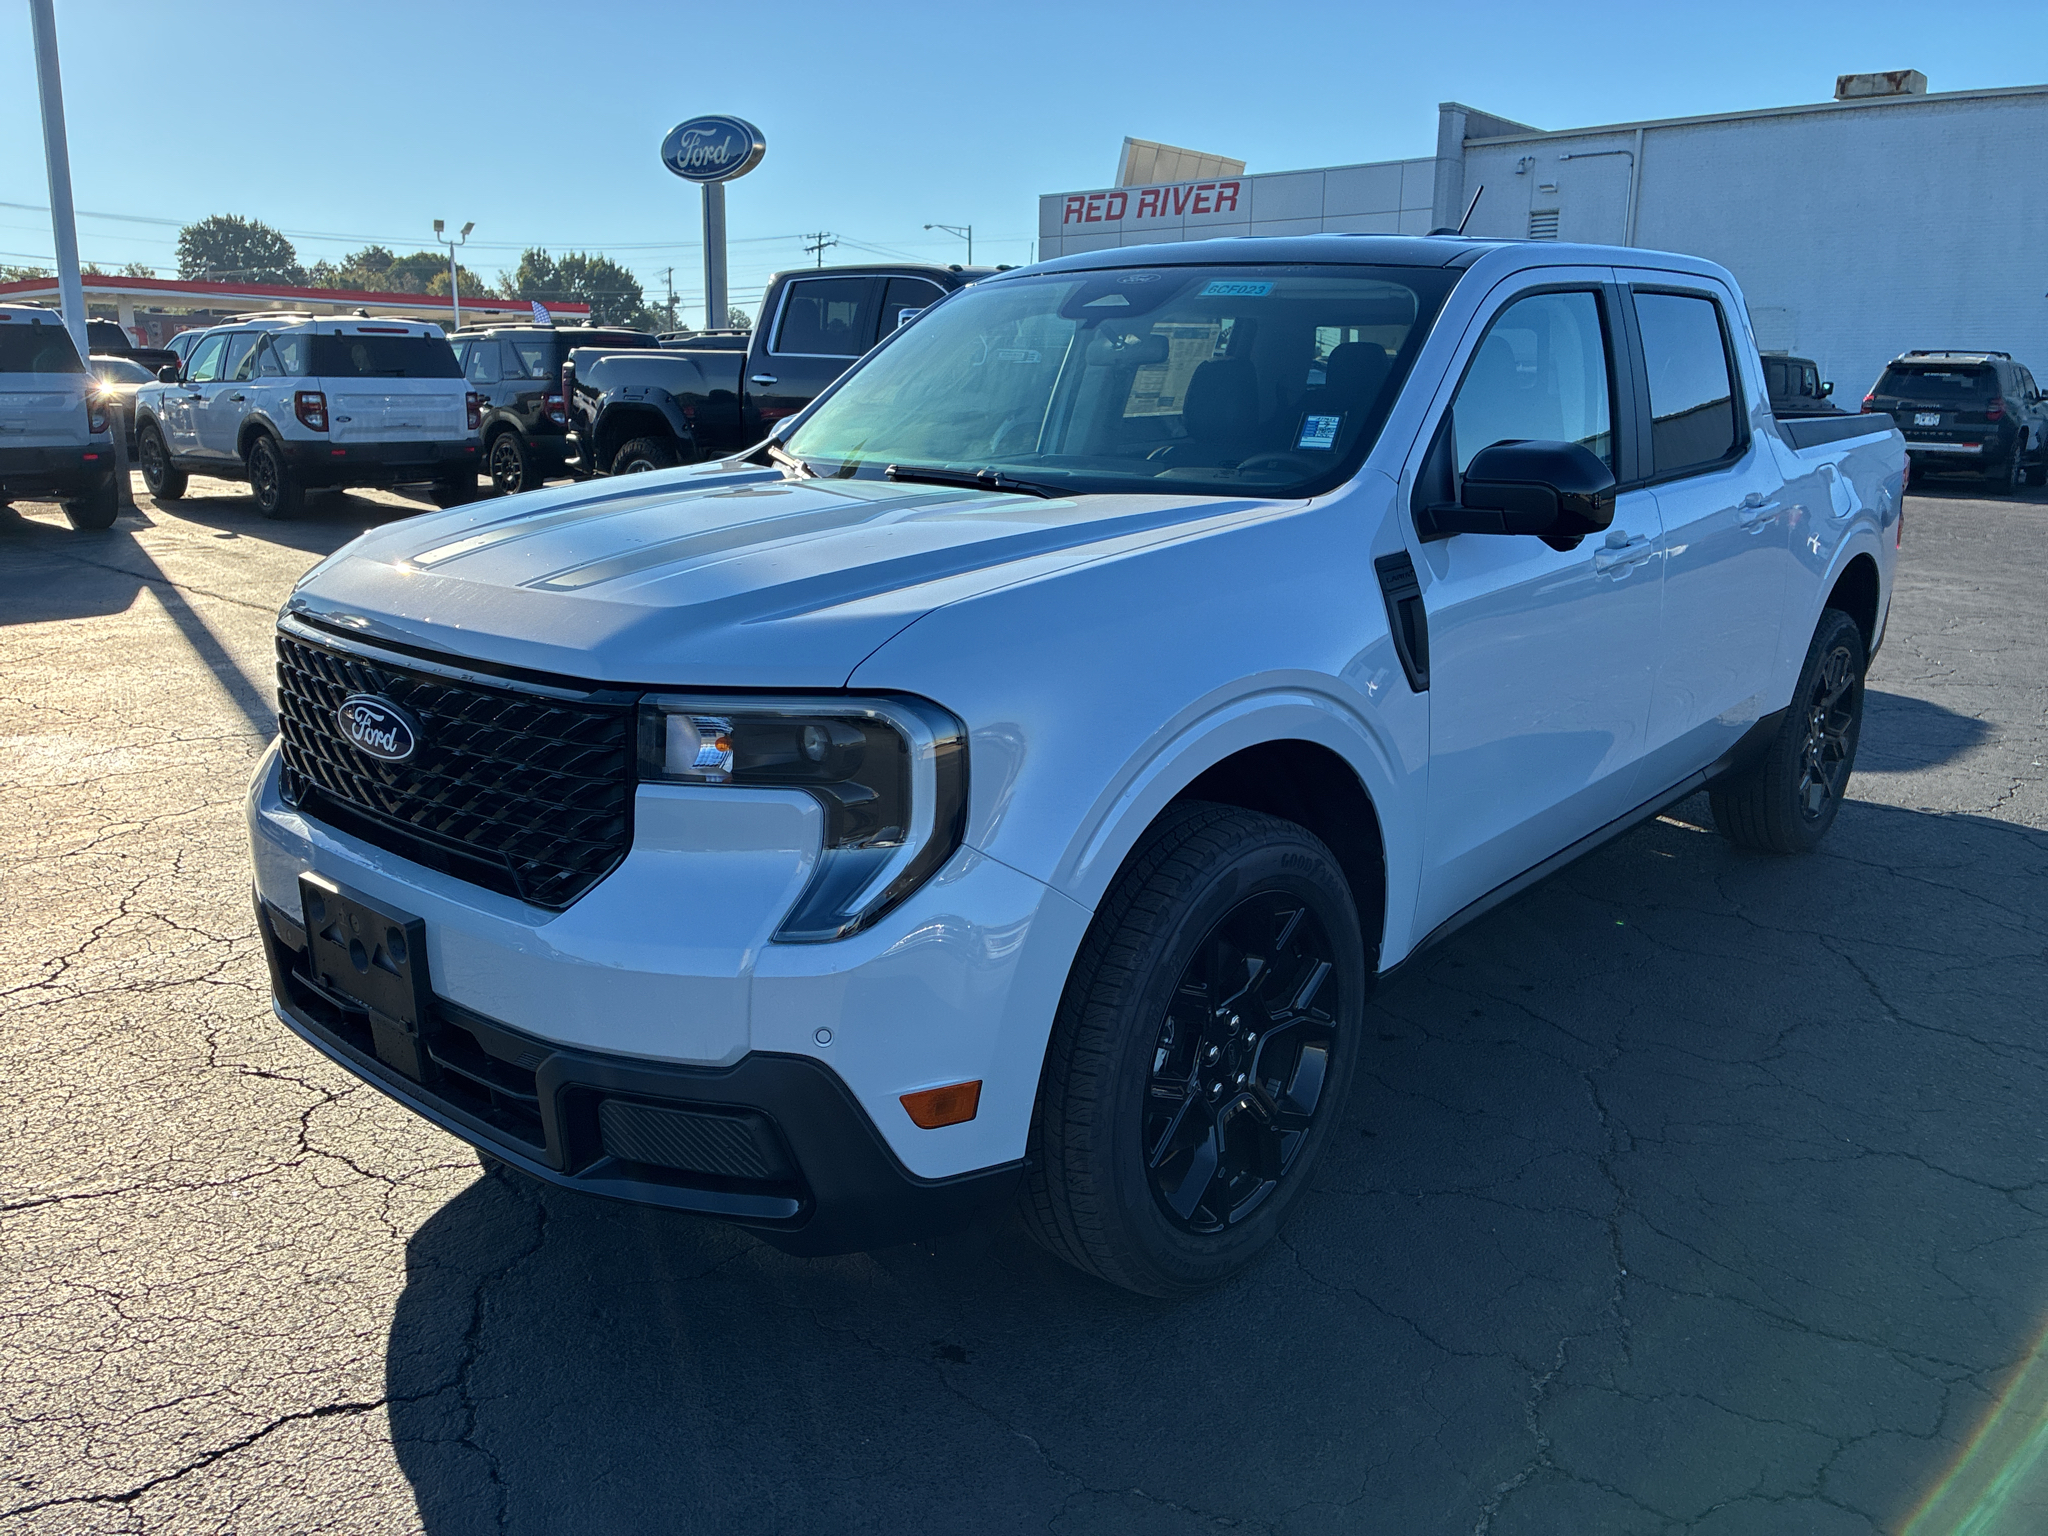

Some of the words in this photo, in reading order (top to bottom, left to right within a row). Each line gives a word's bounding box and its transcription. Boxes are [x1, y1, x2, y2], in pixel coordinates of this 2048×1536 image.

[677, 128, 731, 168] Ford
[1063, 192, 1129, 225] RED
[1136, 181, 1240, 219] RIVER
[351, 706, 398, 753] Ford
